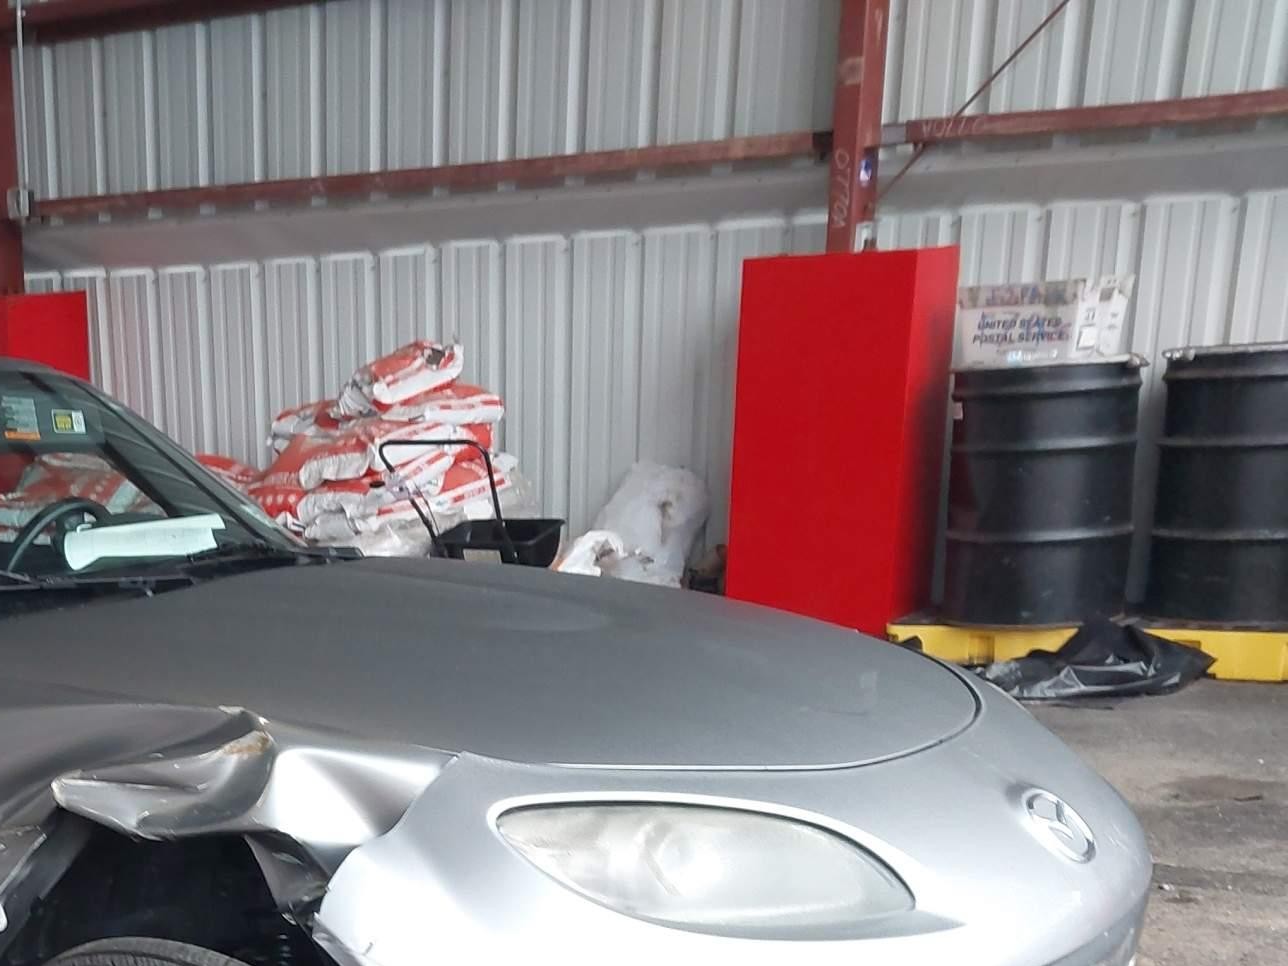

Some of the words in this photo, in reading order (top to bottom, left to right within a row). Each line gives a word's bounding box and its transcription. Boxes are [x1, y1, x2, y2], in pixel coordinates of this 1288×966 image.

[977, 317, 1017, 331] UNITED
[1018, 316, 1063, 330] STATES
[972, 331, 1016, 345] POSTAL
